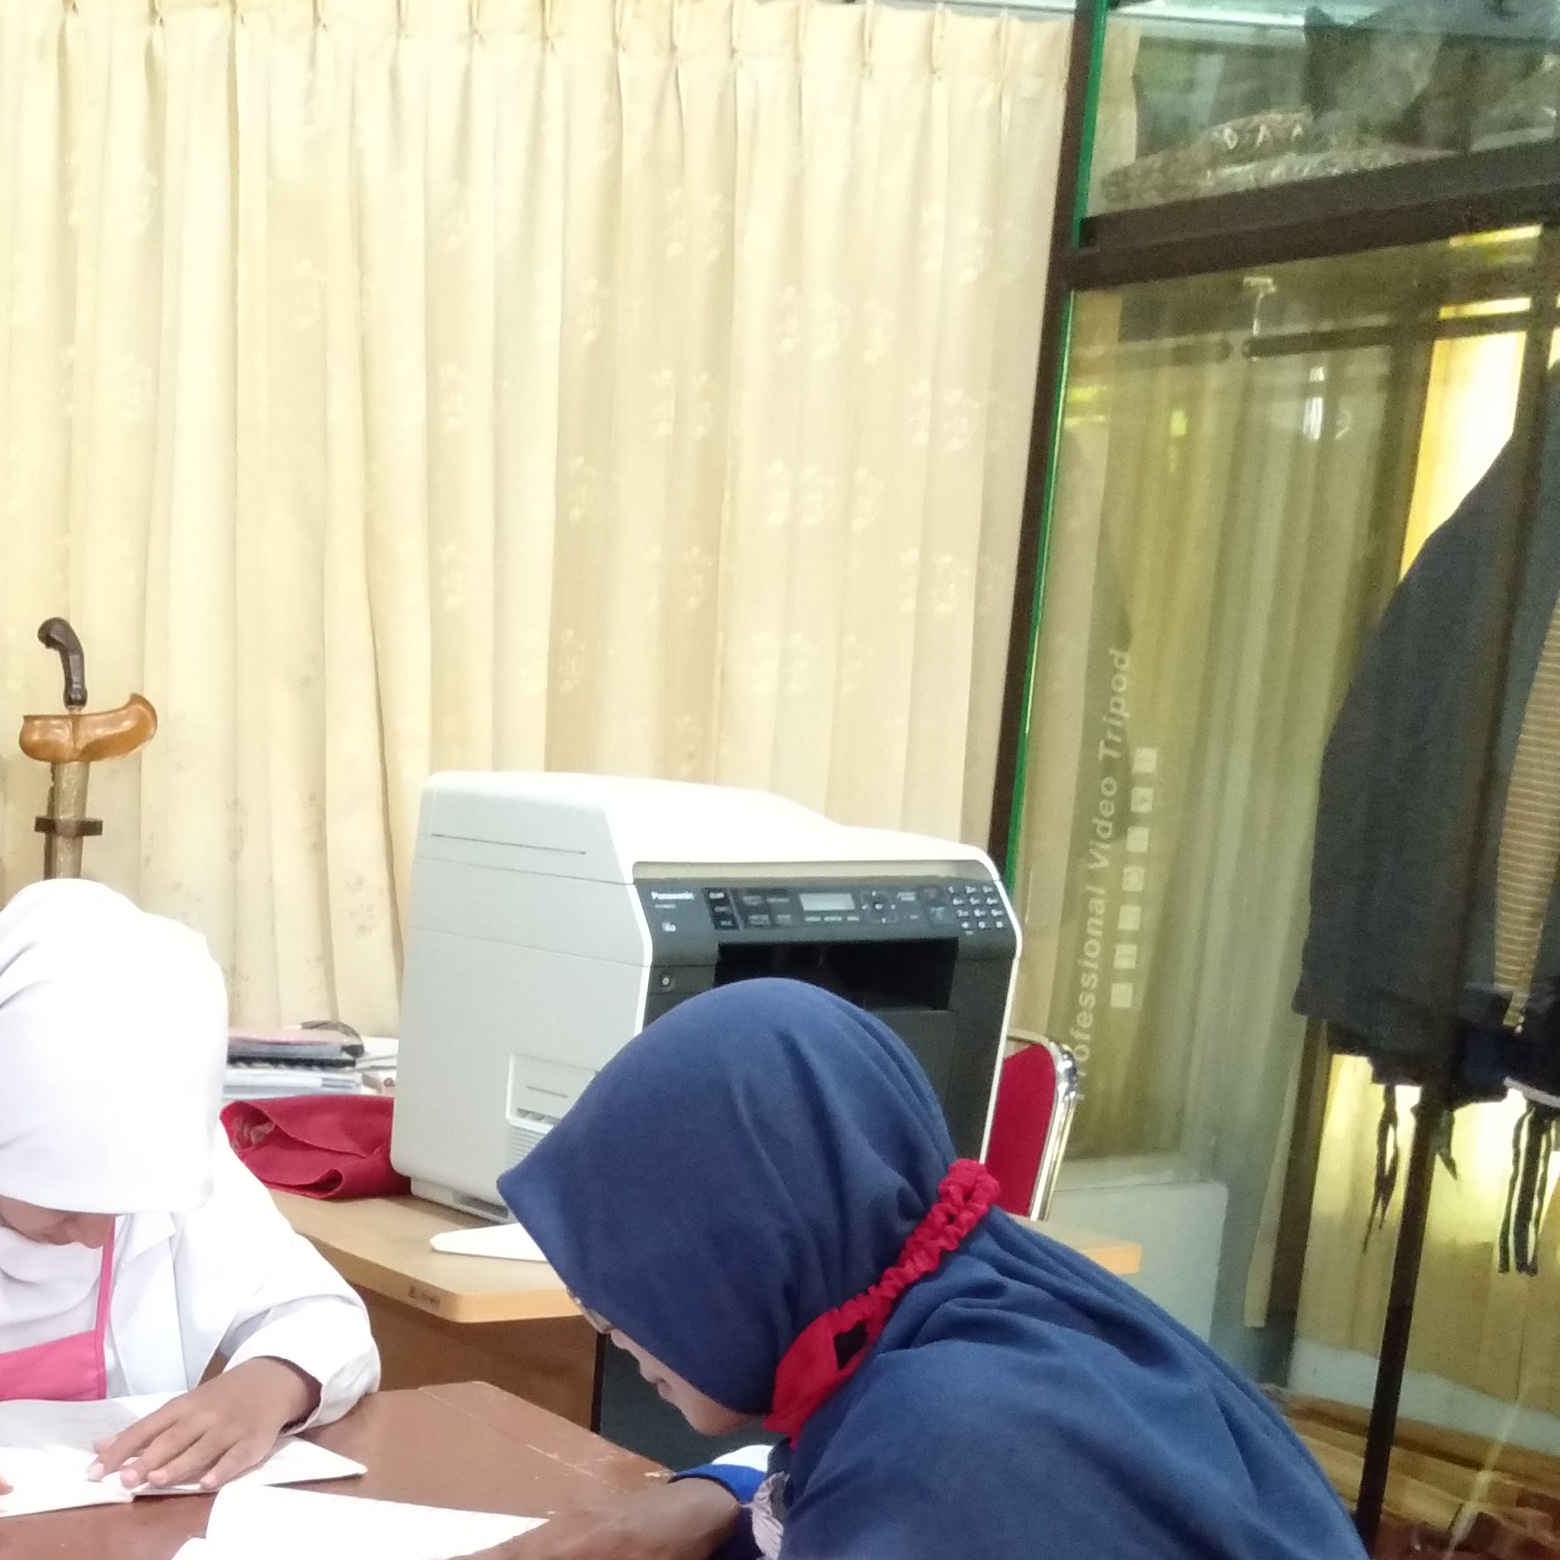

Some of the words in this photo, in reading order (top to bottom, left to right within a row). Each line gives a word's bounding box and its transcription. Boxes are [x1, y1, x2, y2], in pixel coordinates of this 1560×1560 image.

[1098, 648, 1131, 762] Tripod
[1088, 776, 1118, 870] Video
[1069, 885, 1107, 1100] ofessional
